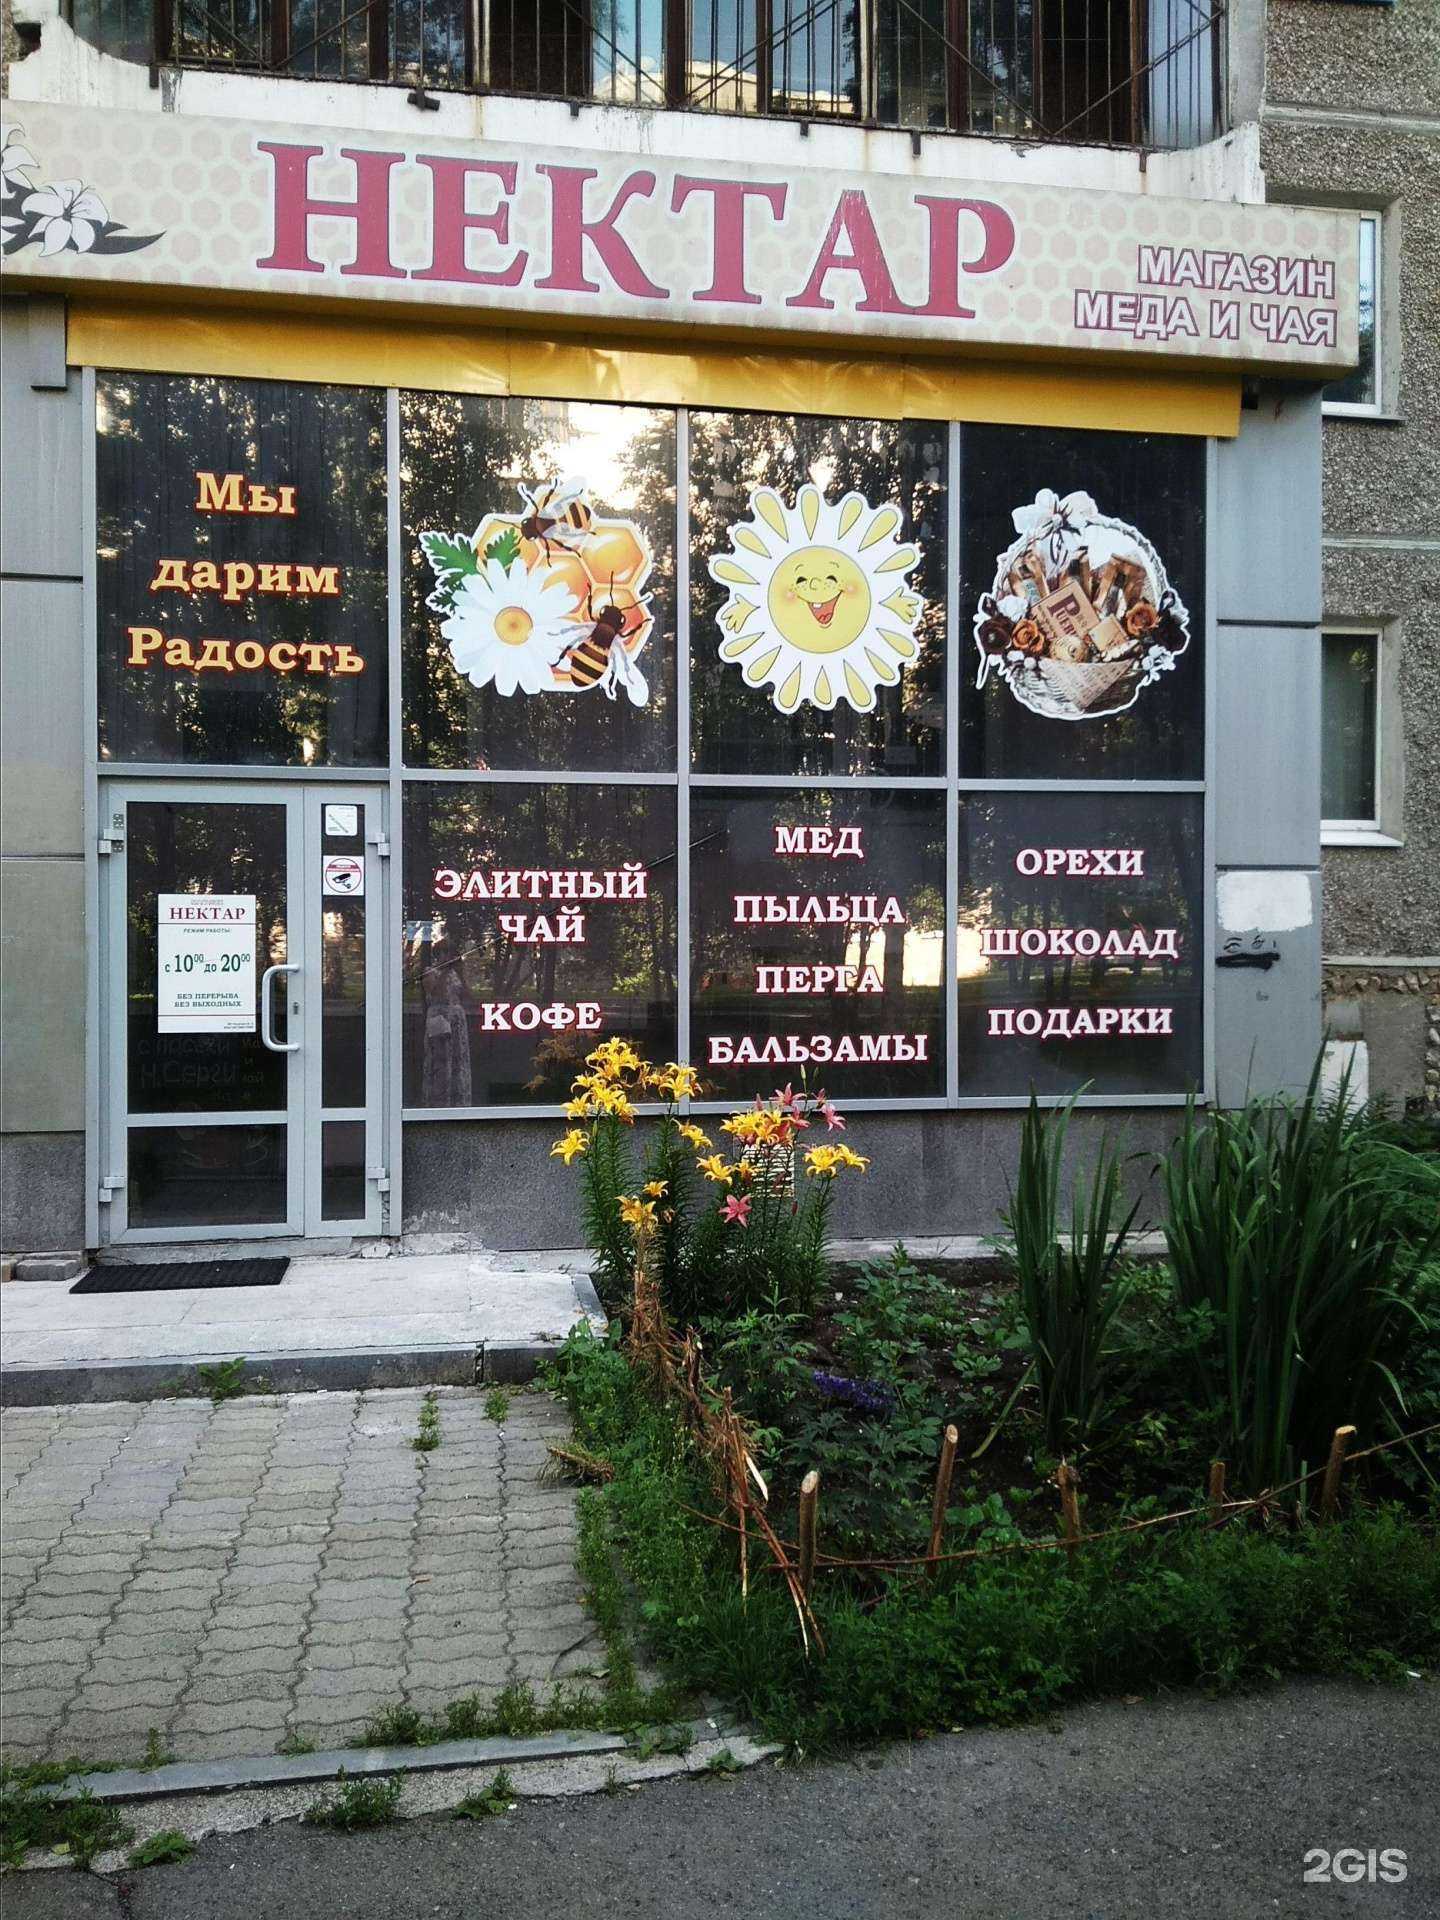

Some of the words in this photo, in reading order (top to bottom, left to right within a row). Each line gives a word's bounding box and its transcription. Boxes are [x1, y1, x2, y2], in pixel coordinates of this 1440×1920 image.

[256, 140, 1016, 319] НЕКТАР
[1138, 244, 1336, 300] МАГАЗИН
[1074, 288, 1200, 341] МЕДА
[1210, 299, 1241, 340] И
[1250, 302, 1338, 348] ЧАЯ
[195, 470, 297, 517] Мы
[149, 557, 340, 603] дарим
[126, 625, 366, 675] Радость
[773, 824, 865, 859] МЕД
[1015, 848, 1145, 876] ОРЕХИ
[433, 861, 649, 900] ЭЛИТНЫЙ
[169, 907, 246, 920] НЕКТАР
[498, 904, 587, 943] ЧАЙ
[732, 894, 906, 926] ПЫЛЬЦА
[980, 928, 1179, 959] ШОКОЛАД
[203, 963, 218, 973] до
[755, 965, 885, 994] ПЕРГА
[480, 1001, 603, 1031] КОФЕ
[987, 1007, 1174, 1038] ПОДАРКИ
[707, 1034, 929, 1065] БАЛЬЗАМЫ
